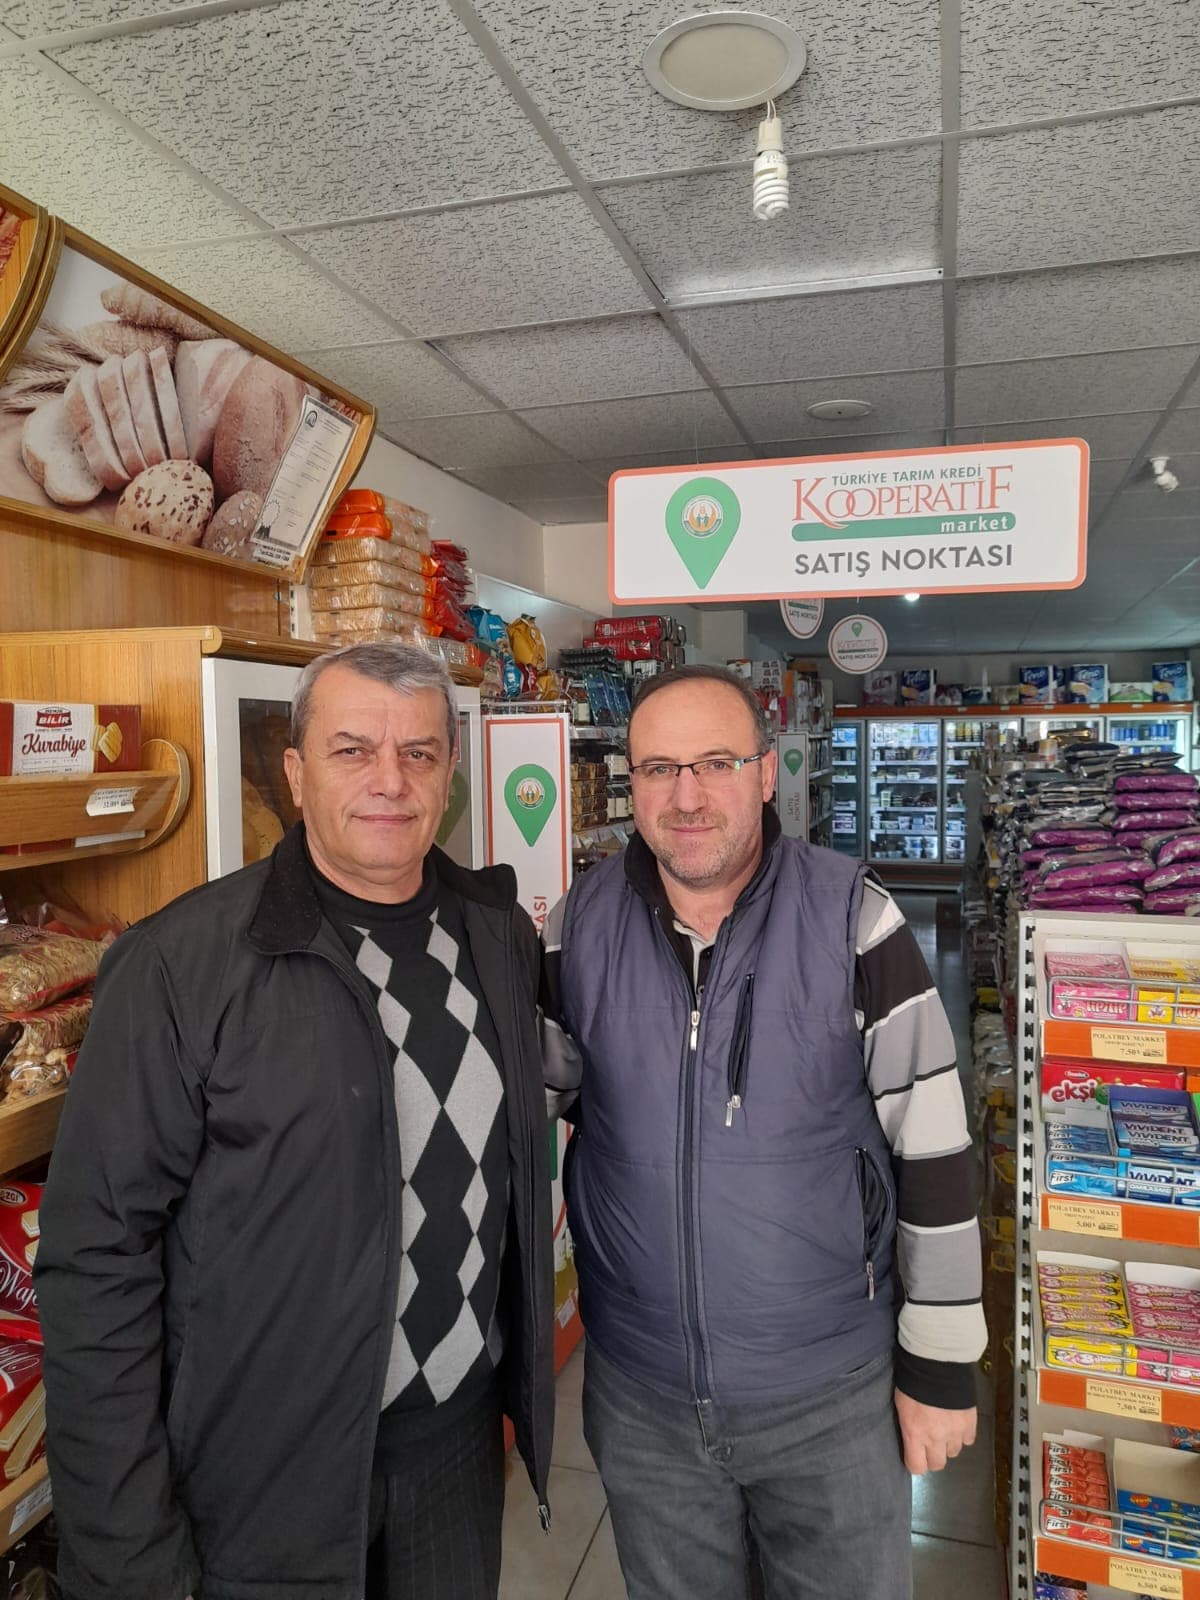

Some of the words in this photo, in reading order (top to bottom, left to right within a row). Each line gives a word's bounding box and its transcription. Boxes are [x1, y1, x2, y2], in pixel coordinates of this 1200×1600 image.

[832, 471, 887, 486] TÜRKİYE
[893, 469, 935, 482] TARIM
[940, 464, 981, 479] KREDİ
[791, 465, 1013, 529] KOOPERATİF
[941, 516, 1008, 532] market
[795, 551, 871, 578] SATIŞ
[881, 544, 1012, 571] NOKTASI
[21, 732, 87, 758] Kurabiye
[1051, 1081, 1097, 1103] ekşi
[1051, 1172, 1074, 1182] First
